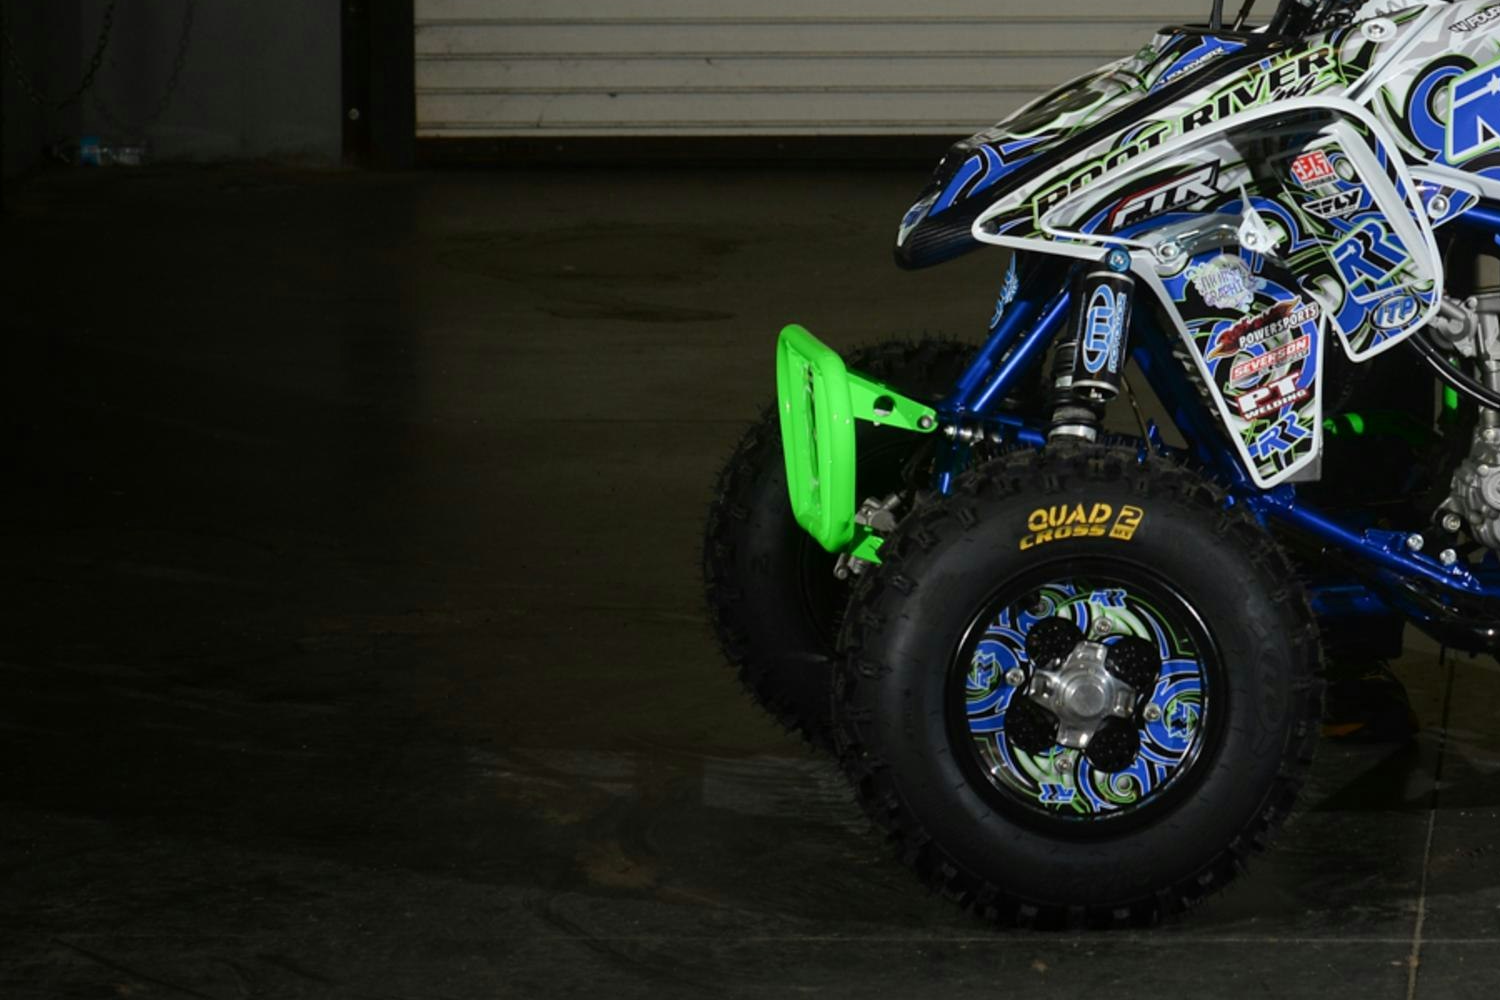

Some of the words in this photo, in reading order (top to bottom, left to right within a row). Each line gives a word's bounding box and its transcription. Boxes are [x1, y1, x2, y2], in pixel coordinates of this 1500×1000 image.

[1182, 51, 1330, 134] RIVER
[1306, 190, 1360, 214] FLY
[1239, 302, 1317, 349] POWERSPORTS
[1376, 296, 1416, 326] ITP
[1233, 336, 1307, 378] SEVERSON
[1238, 372, 1300, 414] PT
[1244, 389, 1307, 420] WELDING
[1028, 502, 1112, 532] QUAD
[1019, 524, 1106, 551] CROSS
